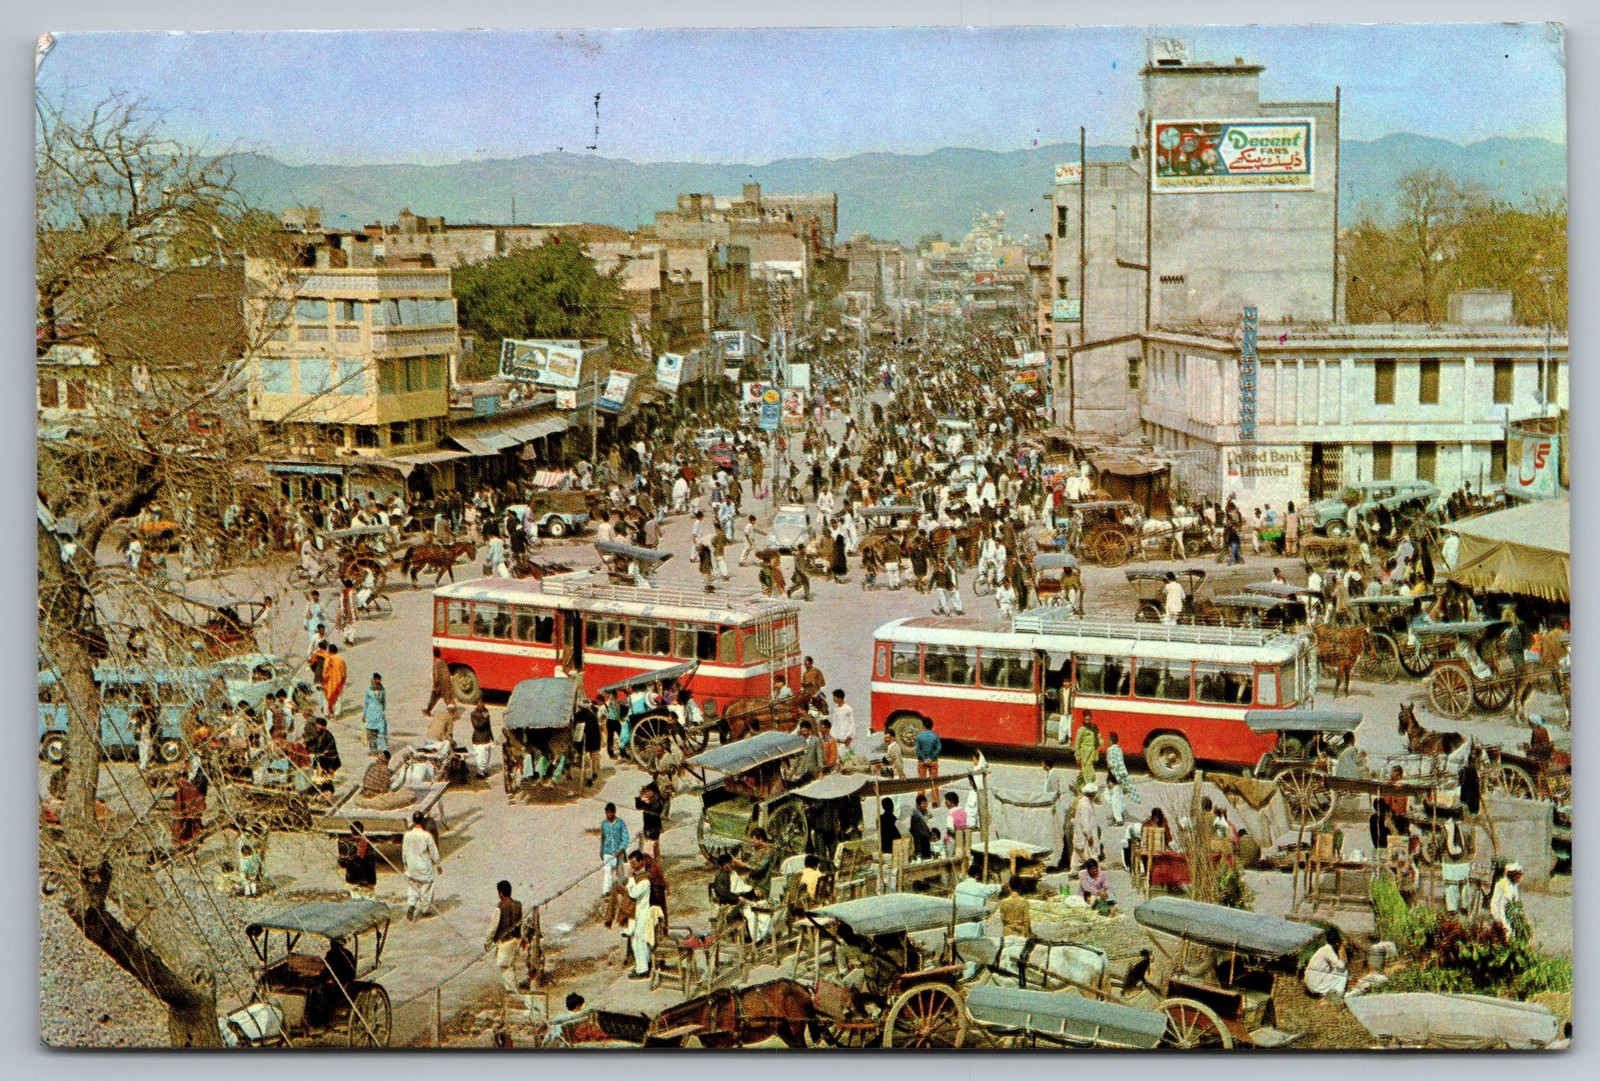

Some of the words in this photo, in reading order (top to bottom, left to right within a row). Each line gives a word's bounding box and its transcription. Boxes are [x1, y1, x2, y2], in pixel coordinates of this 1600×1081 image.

[1228, 129, 1300, 149] Decent
[1260, 147, 1289, 155] FANS
[1270, 448, 1302, 463] Bank
[1239, 464, 1289, 477] Limited
